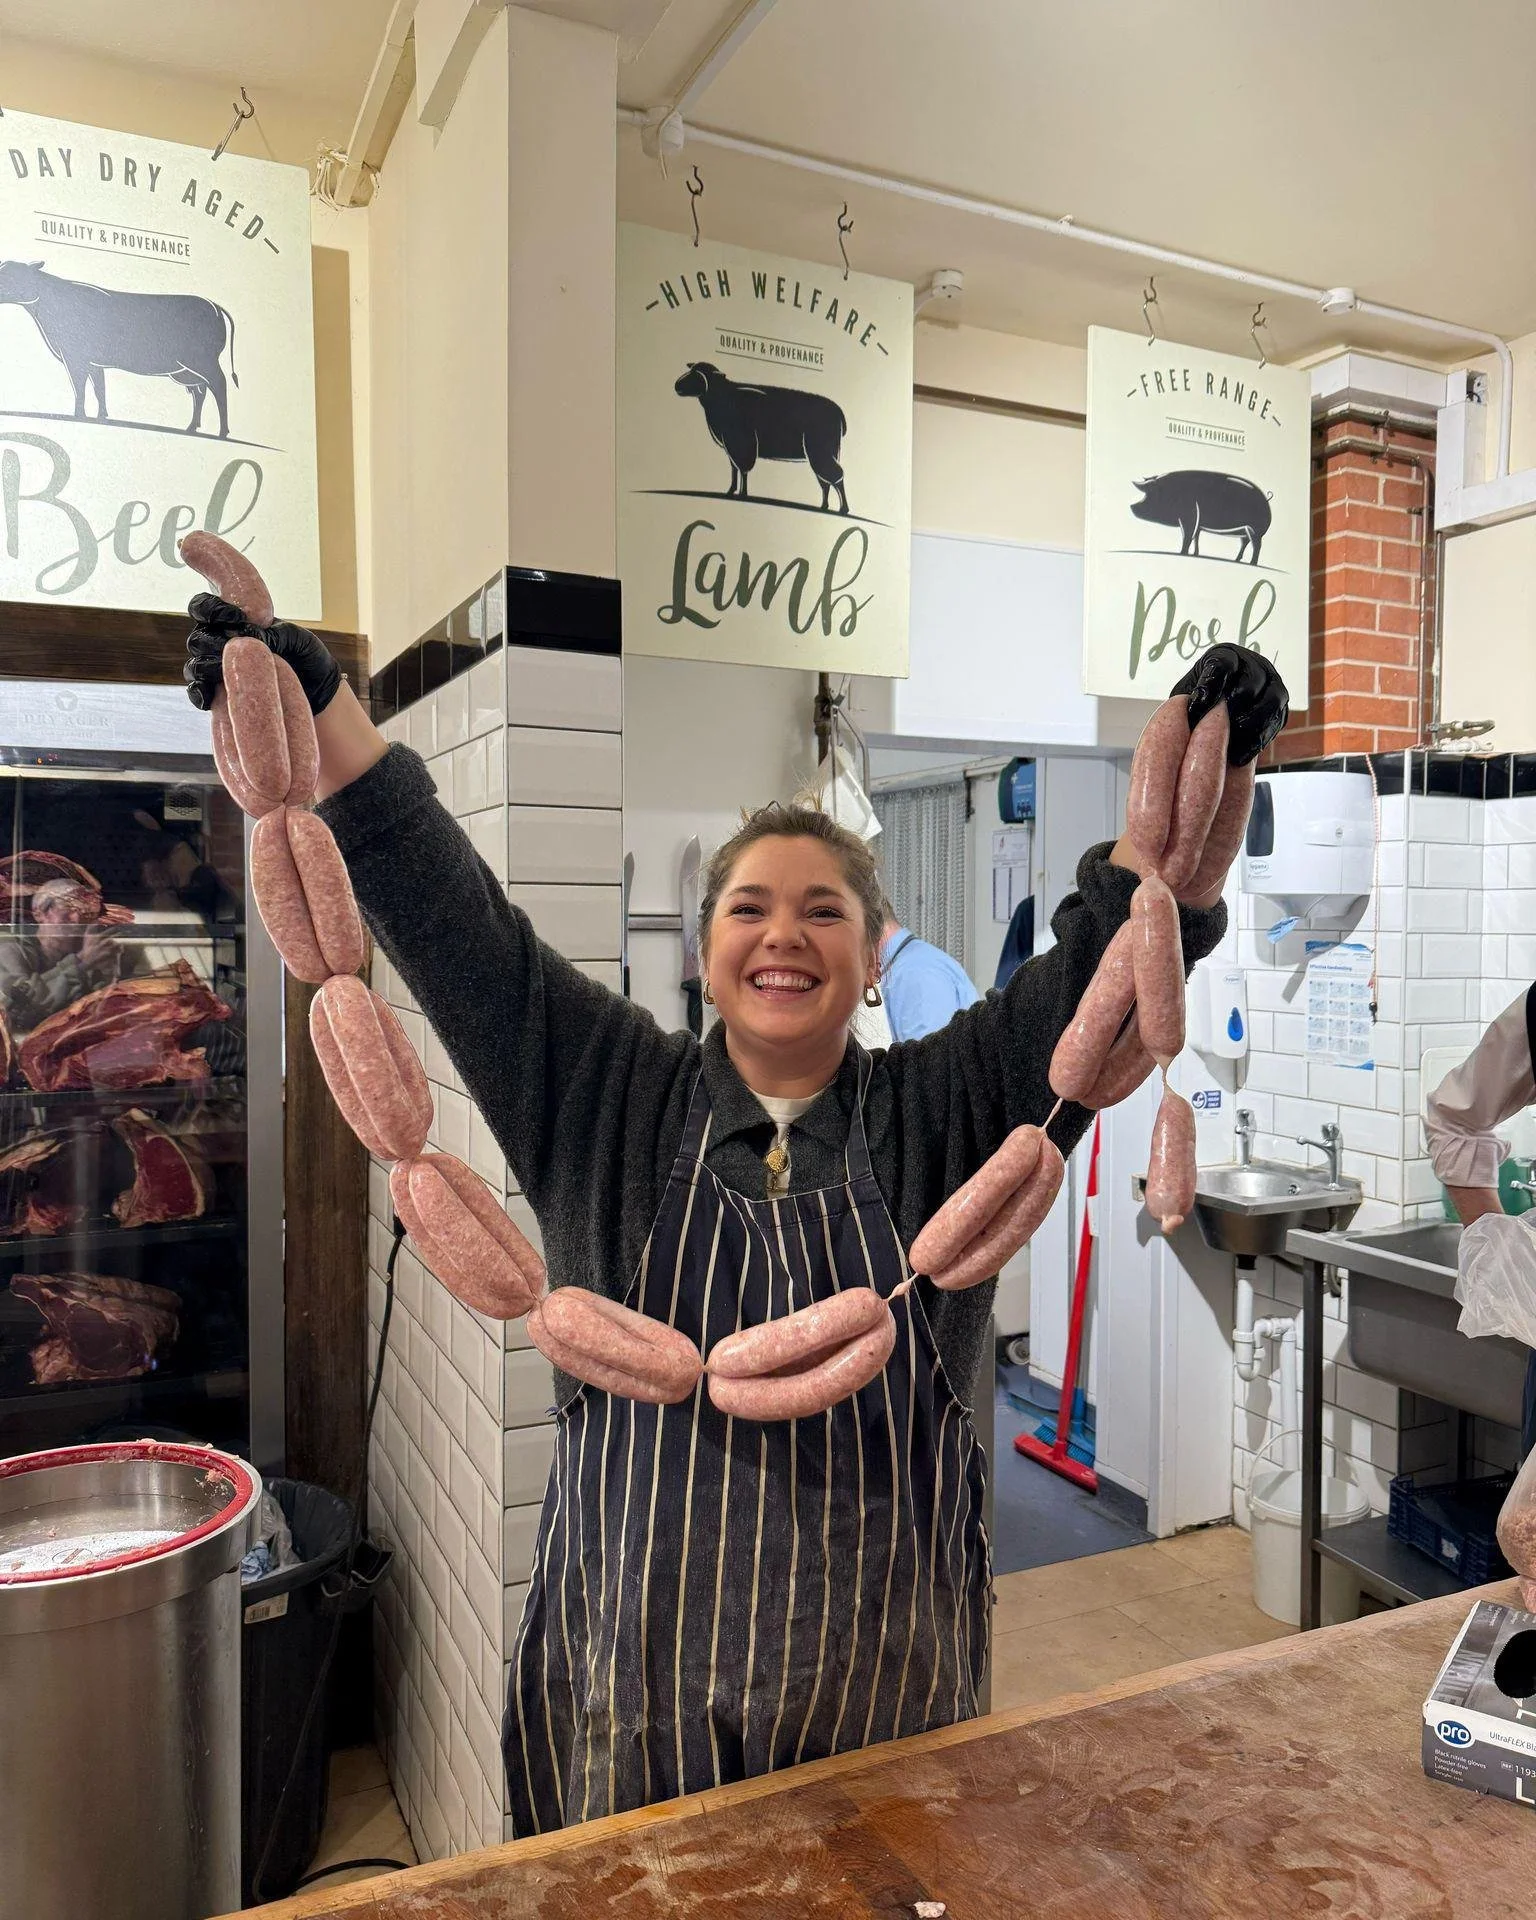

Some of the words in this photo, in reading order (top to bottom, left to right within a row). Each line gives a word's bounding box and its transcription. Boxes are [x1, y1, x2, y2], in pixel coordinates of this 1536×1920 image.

[8, 147, 72, 179] DAY
[99, 152, 162, 193] DRY
[41, 219, 93, 241] QUALITY
[99, 229, 107, 243] &
[113, 231, 191, 257] PROVENANCE
[720, 334, 756, 352] QUALITY
[760, 342, 766, 353] &
[769, 344, 824, 365] PROVENANCE
[1168, 422, 1196, 437] QUALITY
[1198, 428, 1203, 438] &
[1204, 429, 1246, 446] PROVENANCE
[657, 519, 875, 637] Lamb
[1440, 1723, 1470, 1742] pro
[1489, 1731, 1525, 1749] UltraFLEX
[1434, 1749, 1449, 1758] Black
[1450, 1754, 1467, 1763] nitrile
[1467, 1760, 1487, 1769] gloves
